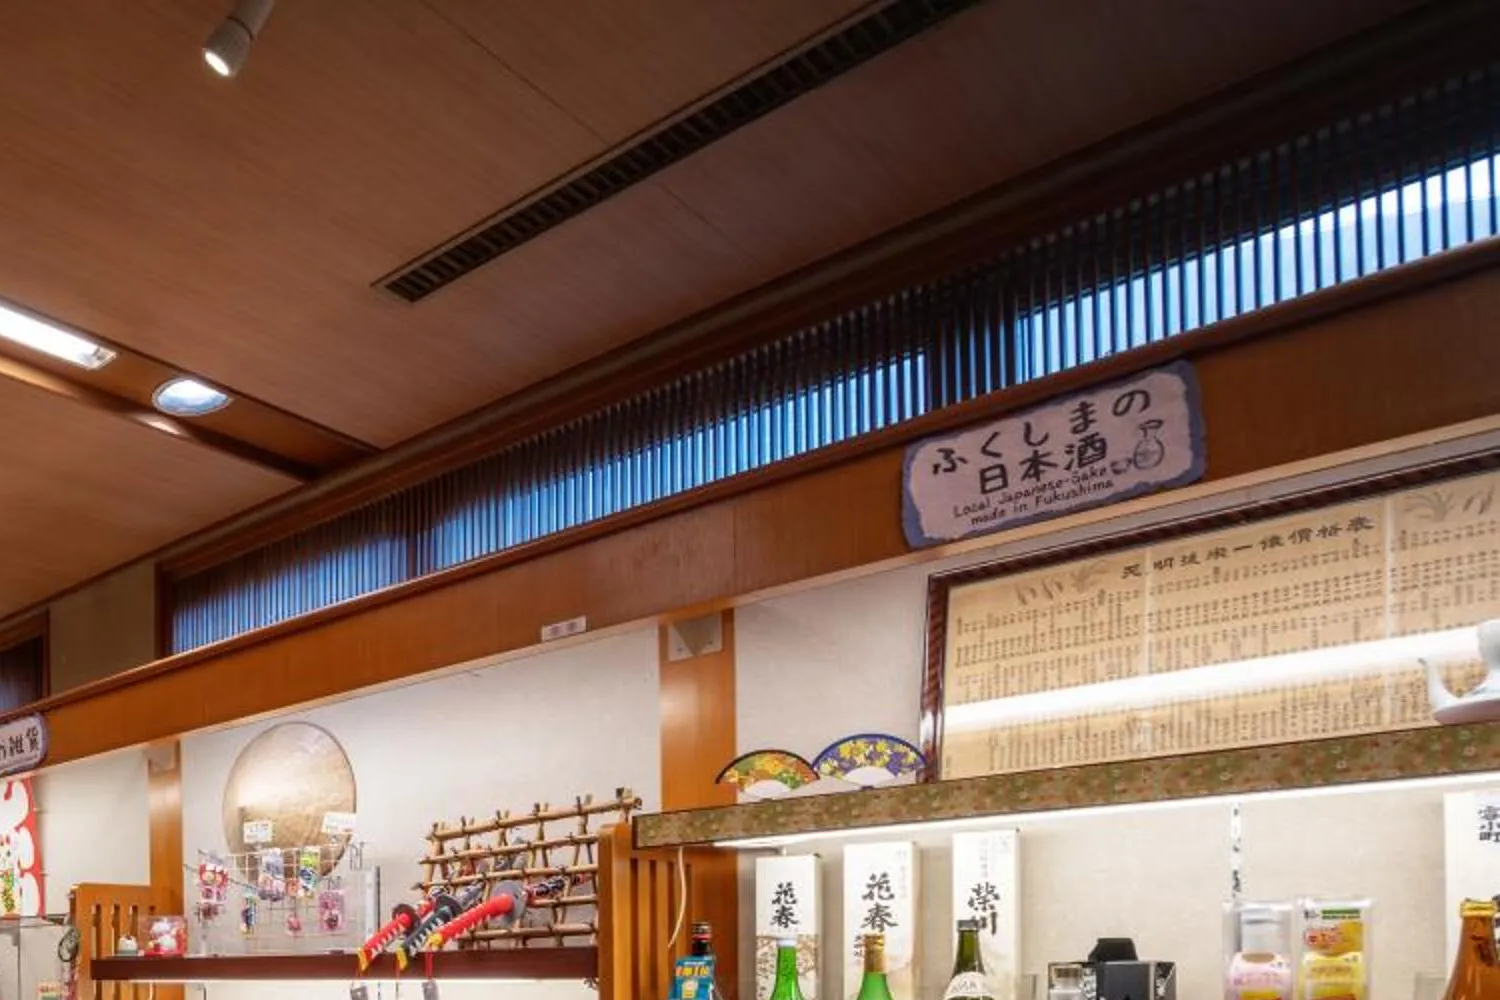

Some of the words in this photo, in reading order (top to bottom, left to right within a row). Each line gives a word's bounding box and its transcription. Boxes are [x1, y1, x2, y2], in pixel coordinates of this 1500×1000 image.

[932, 389, 1151, 475] ふくしまの
[978, 431, 1108, 495] 日本酒
[953, 496, 991, 518] Local
[971, 507, 1006, 525] made
[1013, 501, 1028, 513] in
[1035, 479, 1114, 507] Fukushima
[769, 881, 800, 929] 花春
[861, 872, 900, 933] 花春
